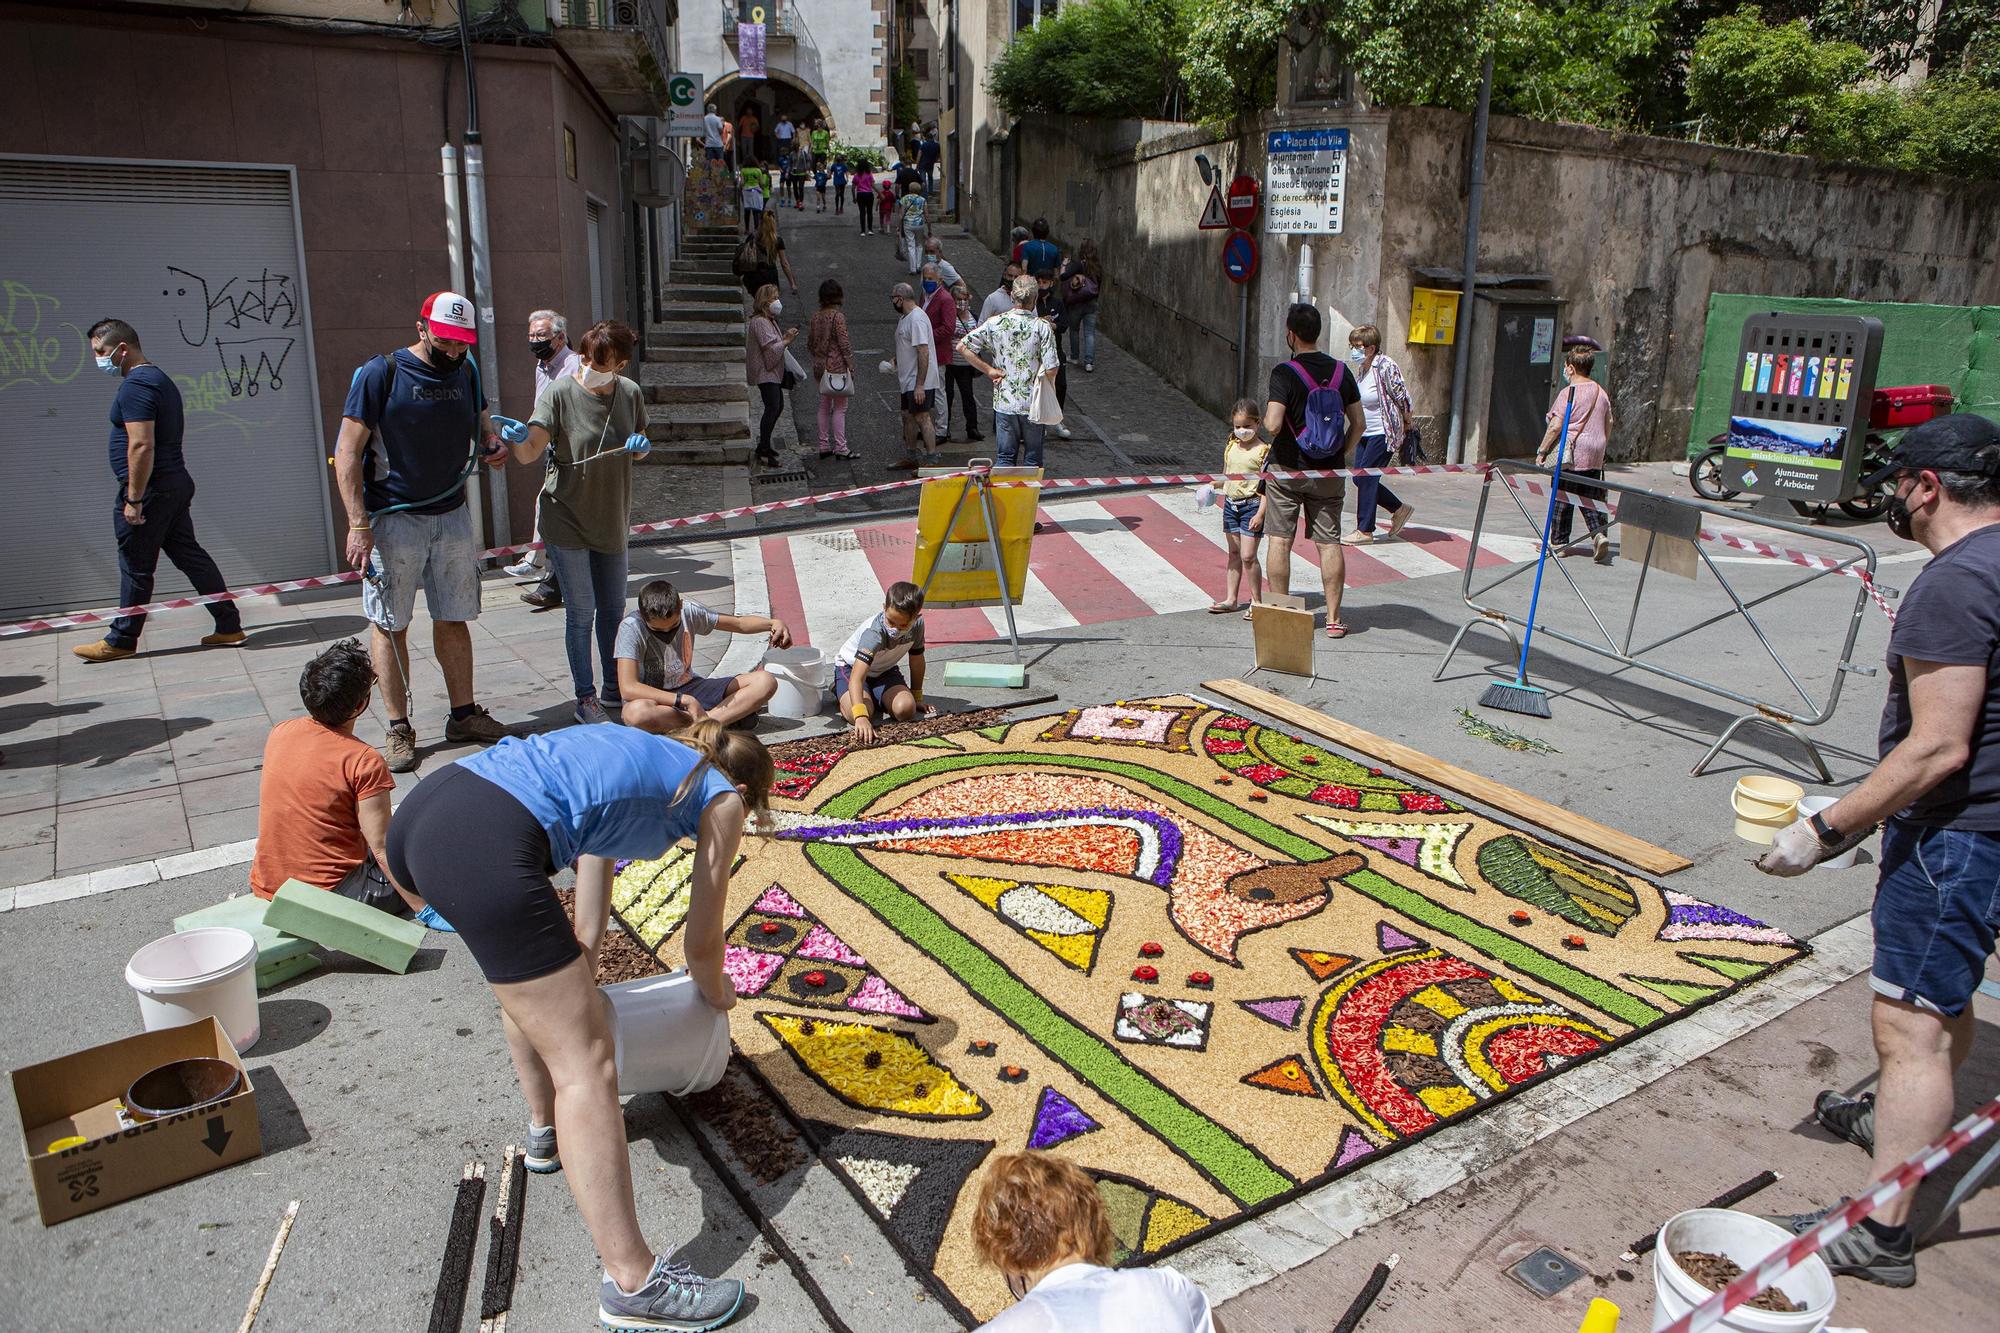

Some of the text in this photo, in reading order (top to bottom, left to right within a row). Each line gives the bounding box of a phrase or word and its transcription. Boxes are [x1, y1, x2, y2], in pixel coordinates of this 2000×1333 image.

[1287, 135, 1342, 148] Plaça de la Vila
[1273, 153, 1315, 164] Ajuntament
[1272, 166, 1331, 175] Oficina de Turisme
[1271, 180, 1294, 189] Museu
[1282, 193, 1291, 202] de
[1270, 207, 1301, 218] Església
[1269, 220, 1318, 231] Jutjat de Pau
[1774, 467, 1819, 481] Ajuntament
[1783, 480, 1815, 491] Arbúcies
